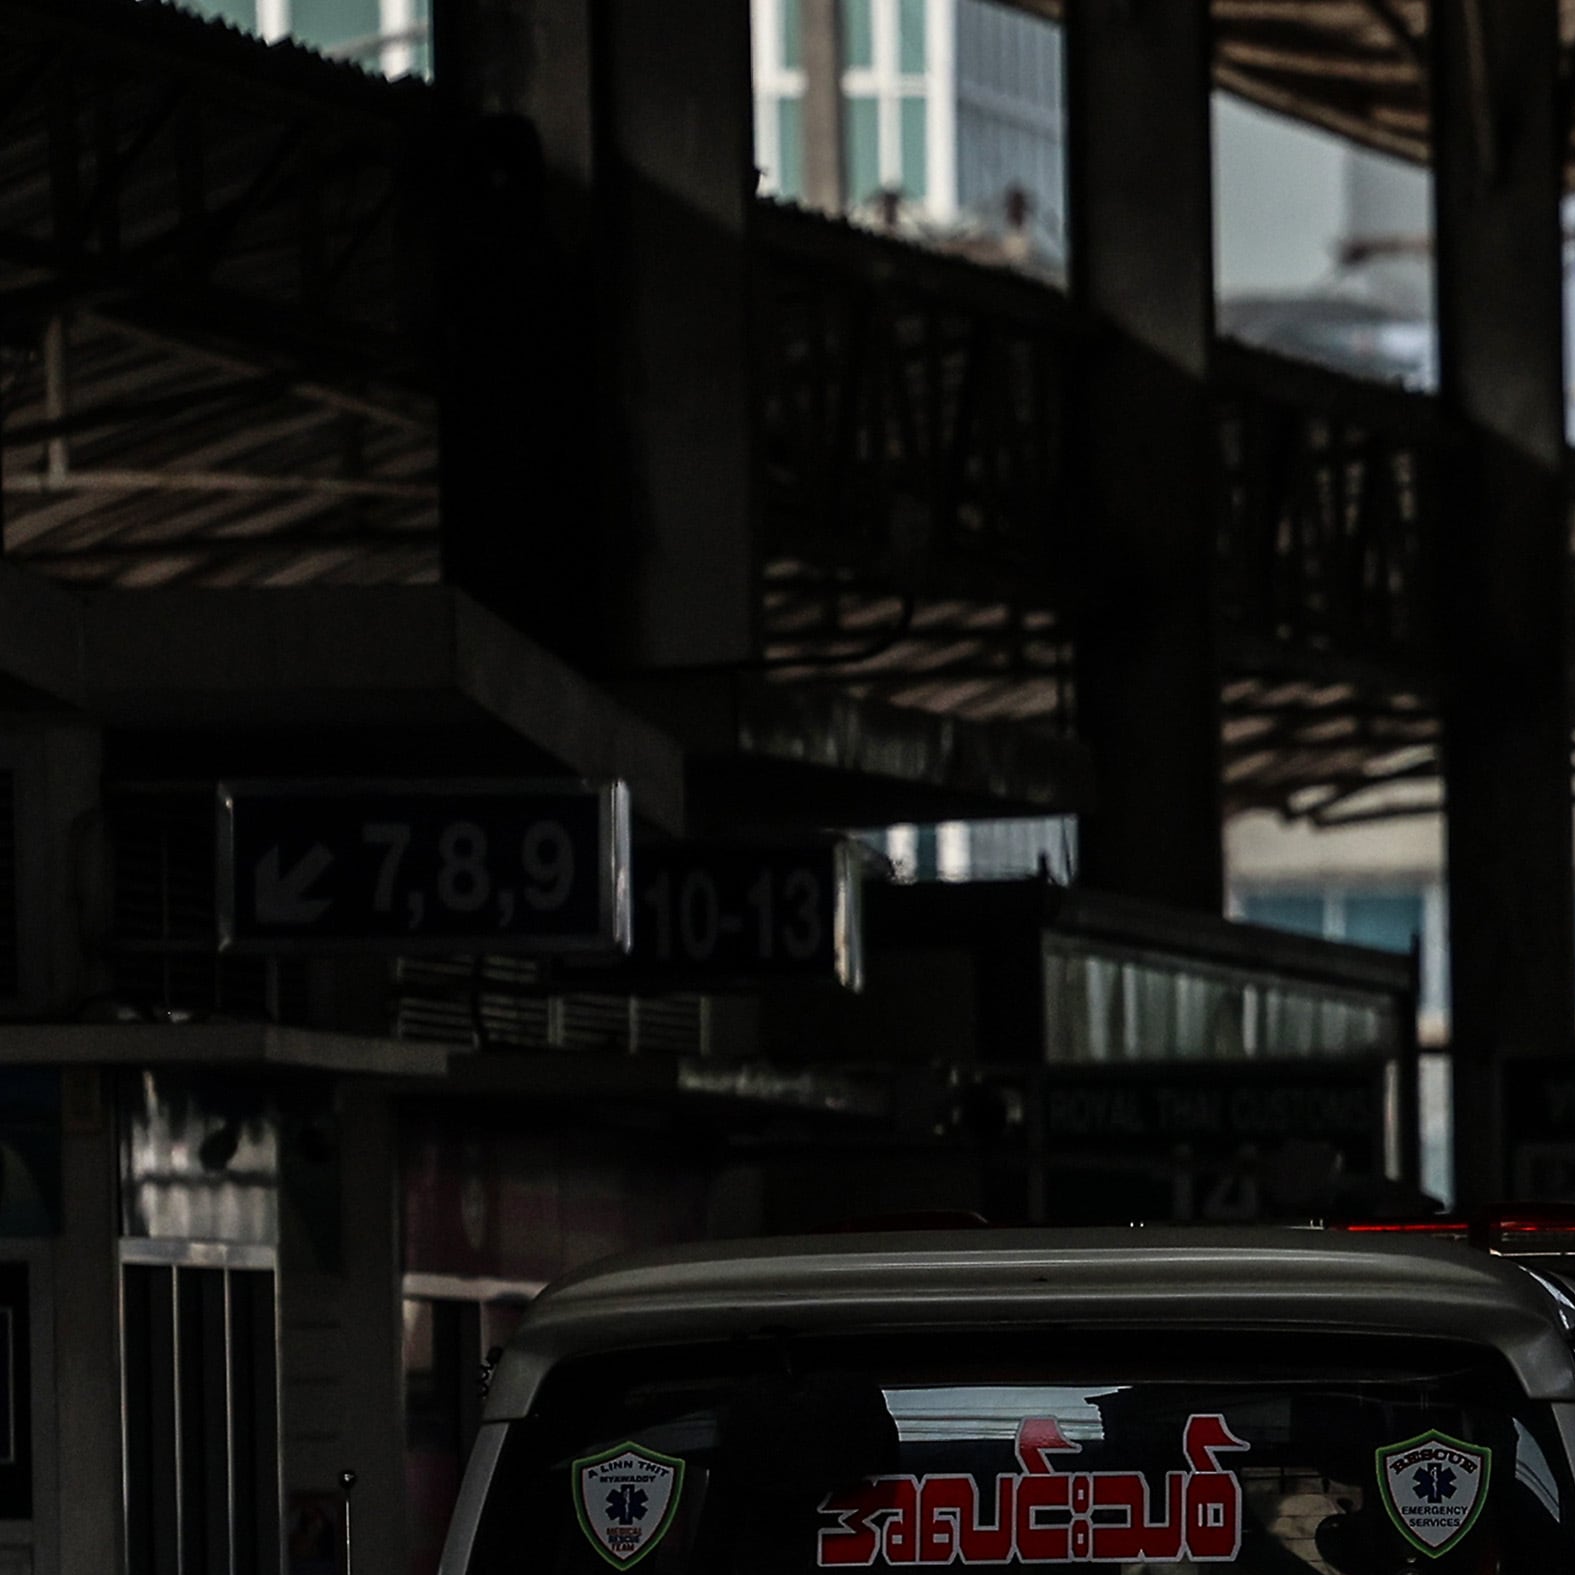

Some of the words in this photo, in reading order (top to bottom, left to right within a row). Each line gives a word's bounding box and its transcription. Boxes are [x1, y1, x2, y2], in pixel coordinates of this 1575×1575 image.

[361, 820, 577, 931] 7,8,9
[645, 865, 822, 960] 10-13
[1050, 1087, 1147, 1131] ROYAL
[587, 1468, 599, 1479] A
[600, 1460, 634, 1474] LINN
[637, 1460, 670, 1478] THIT
[1389, 1448, 1478, 1475] RESCUE
[816, 1412, 1253, 1568] အလင်းသစ်
[1401, 1505, 1469, 1516] EMERGENCY
[1409, 1517, 1461, 1528] SERVICES
[611, 1542, 635, 1551] TEAM
